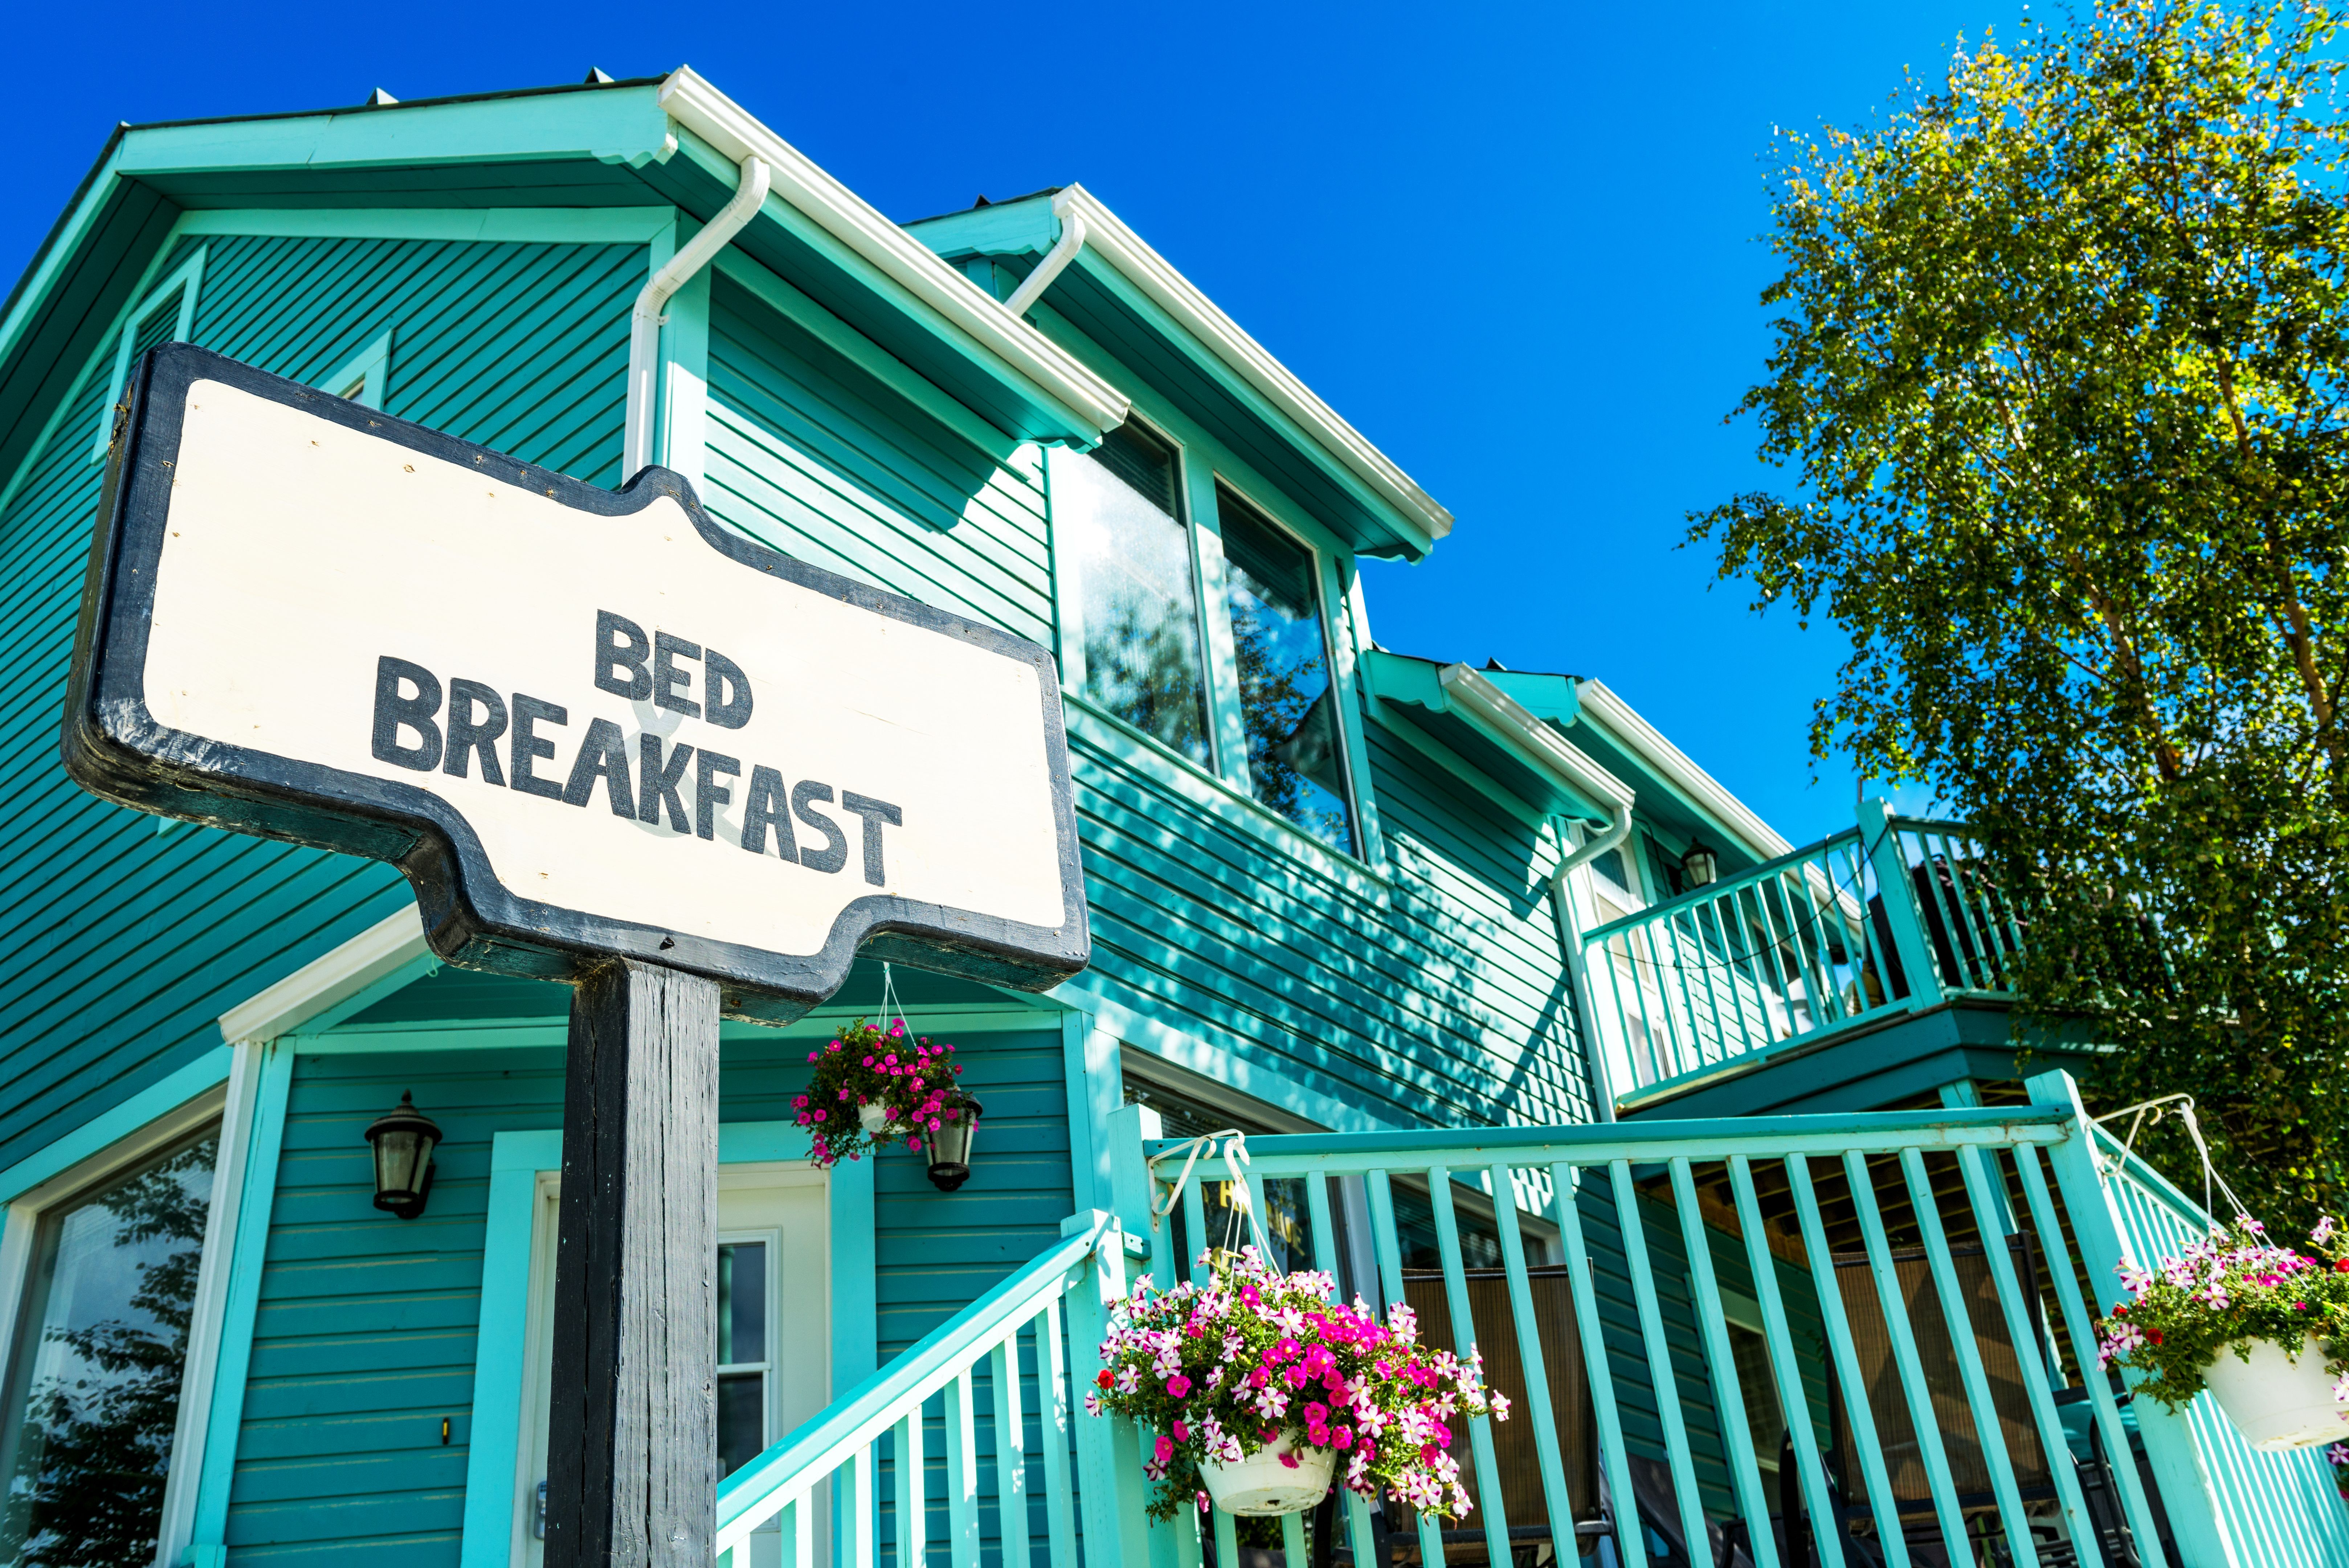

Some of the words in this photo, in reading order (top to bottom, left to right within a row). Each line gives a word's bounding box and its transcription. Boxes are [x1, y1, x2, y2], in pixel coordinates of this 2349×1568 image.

[594, 609, 753, 729] BED
[619, 659, 779, 858] &
[371, 655, 902, 887] BREAKFAST
